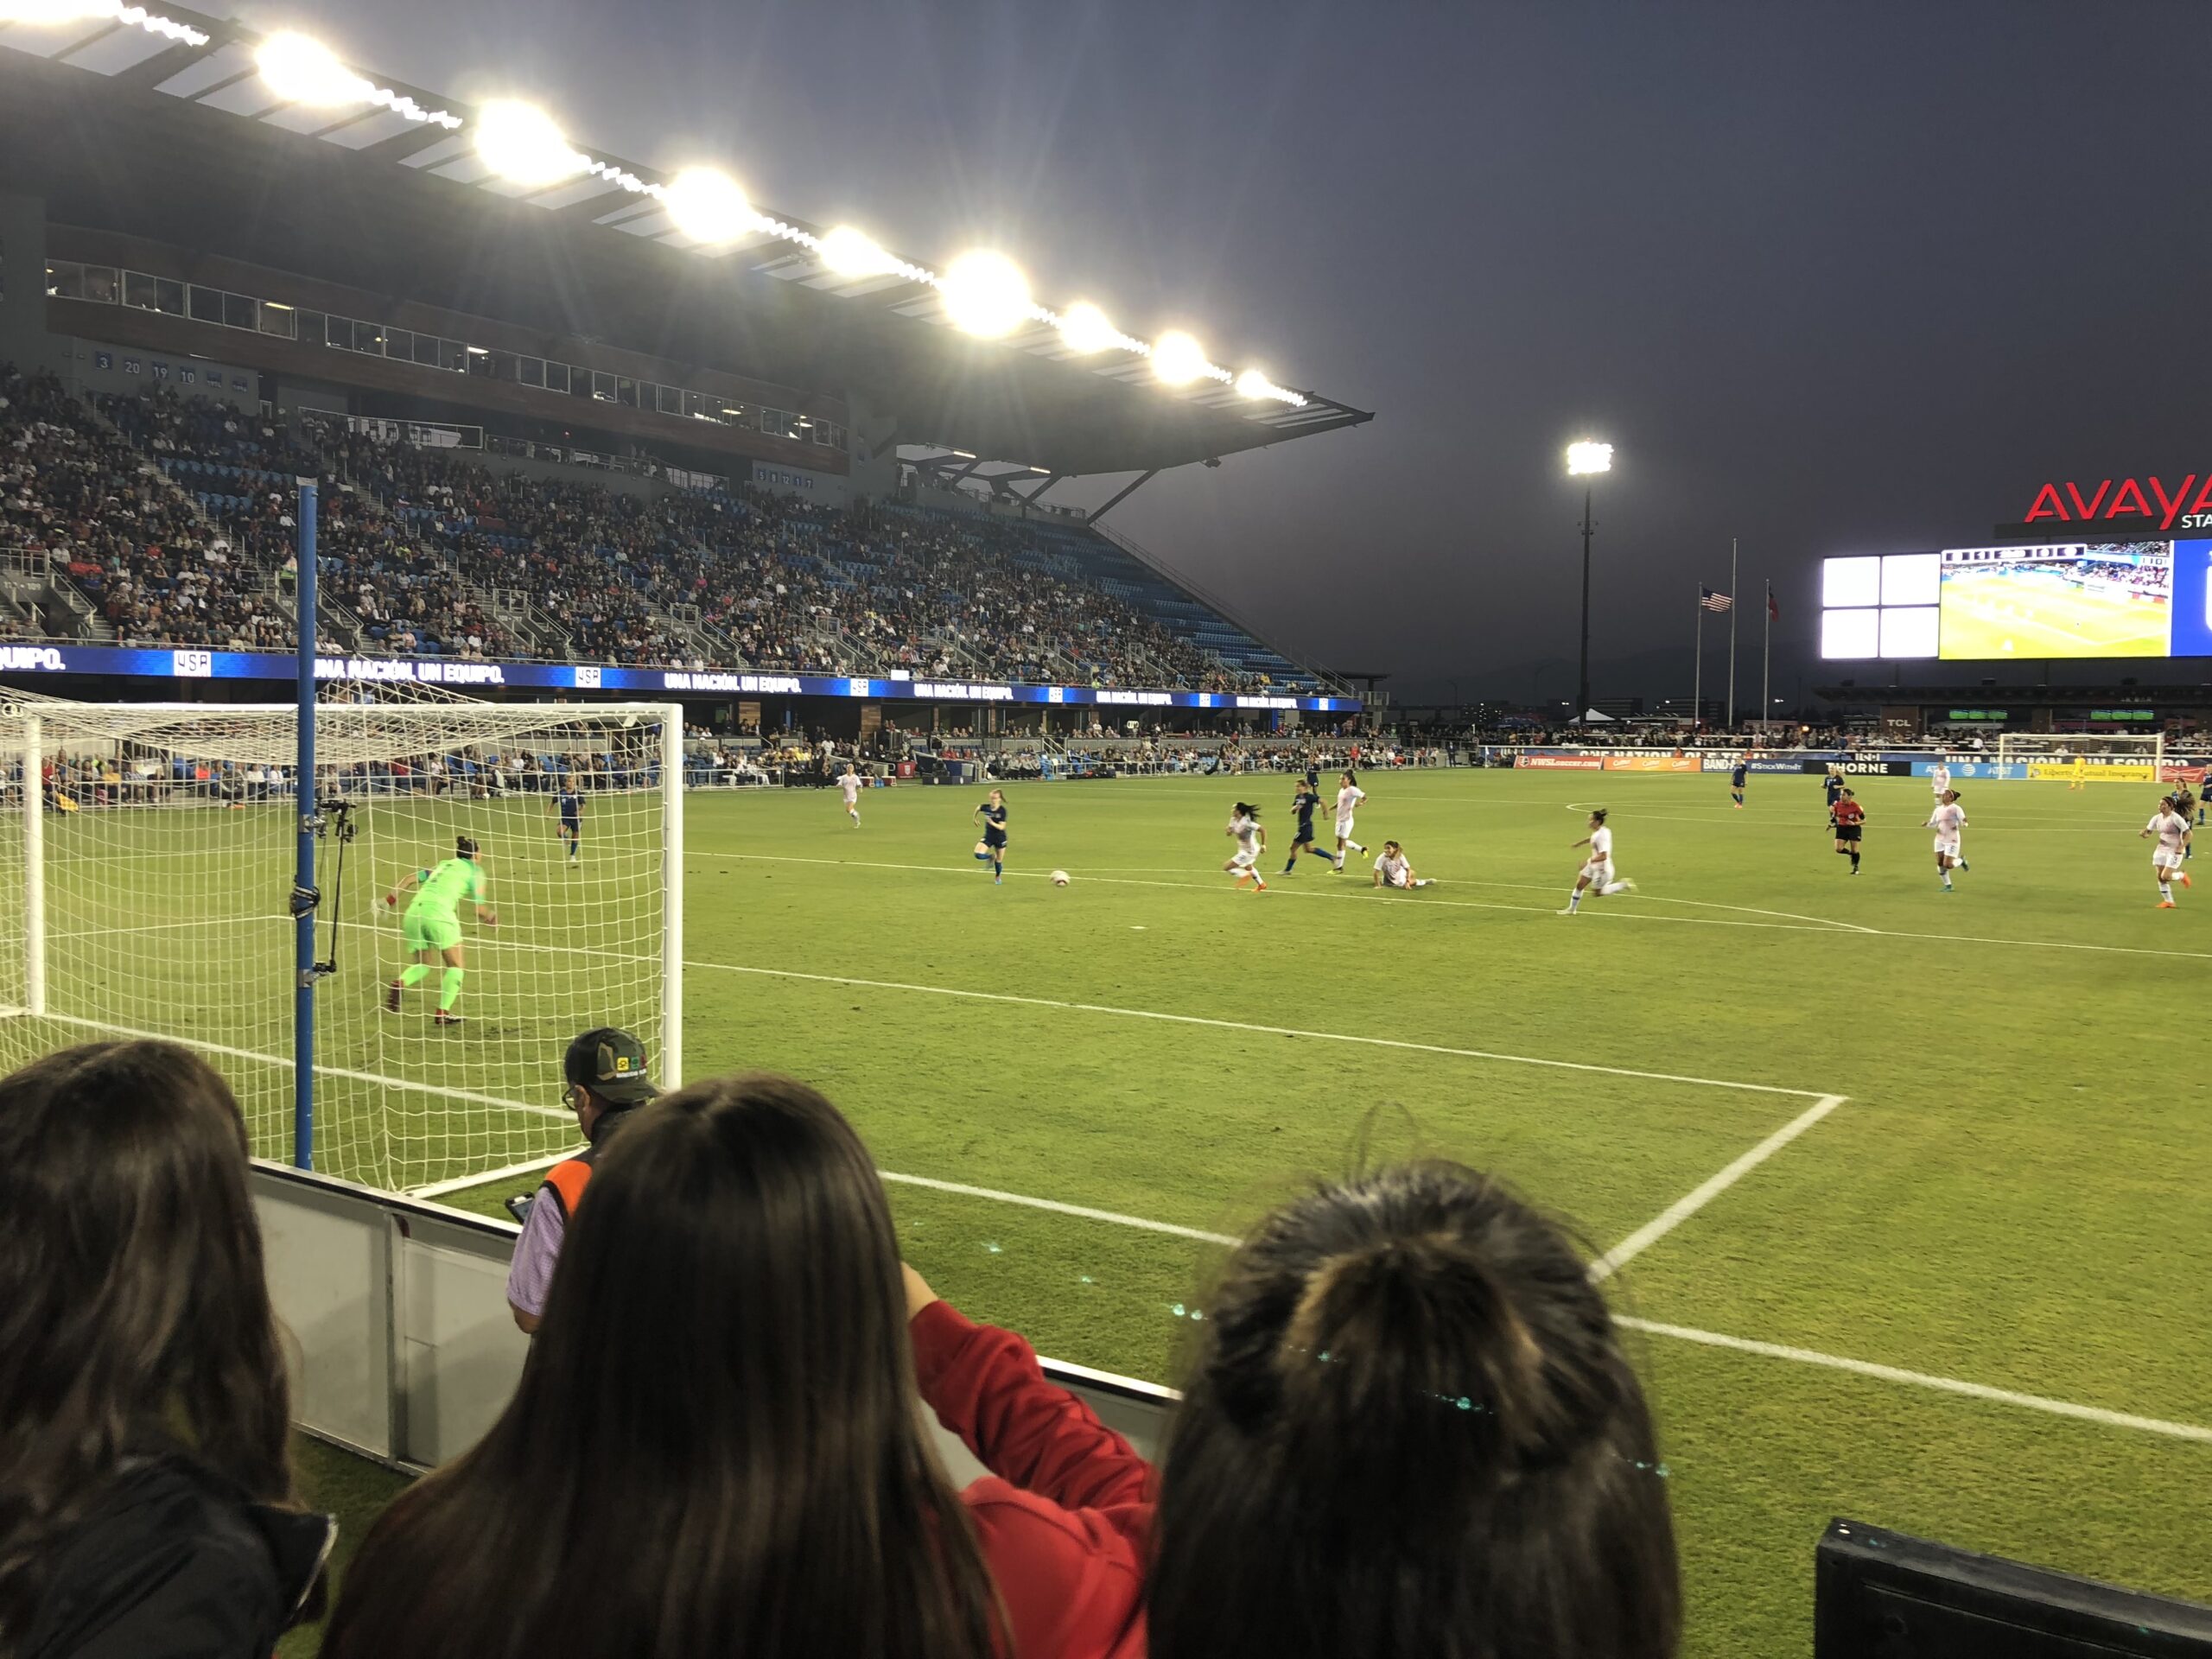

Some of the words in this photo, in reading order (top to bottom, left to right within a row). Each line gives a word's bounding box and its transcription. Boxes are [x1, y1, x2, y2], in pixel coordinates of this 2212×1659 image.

[100, 357, 108, 368] 3
[124, 361, 140, 373] 20
[154, 366, 168, 378] 19
[181, 372, 194, 383] 10
[0, 647, 66, 671] UIPO.
[177, 653, 208, 671] USA
[418, 663, 442, 681] UN
[577, 668, 599, 684] USA
[664, 672, 691, 690] UNA
[741, 676, 759, 691] UN
[1886, 719, 1911, 728] TCL
[1703, 759, 1745, 770] BAND-A
[1826, 762, 1888, 774] THORNE
